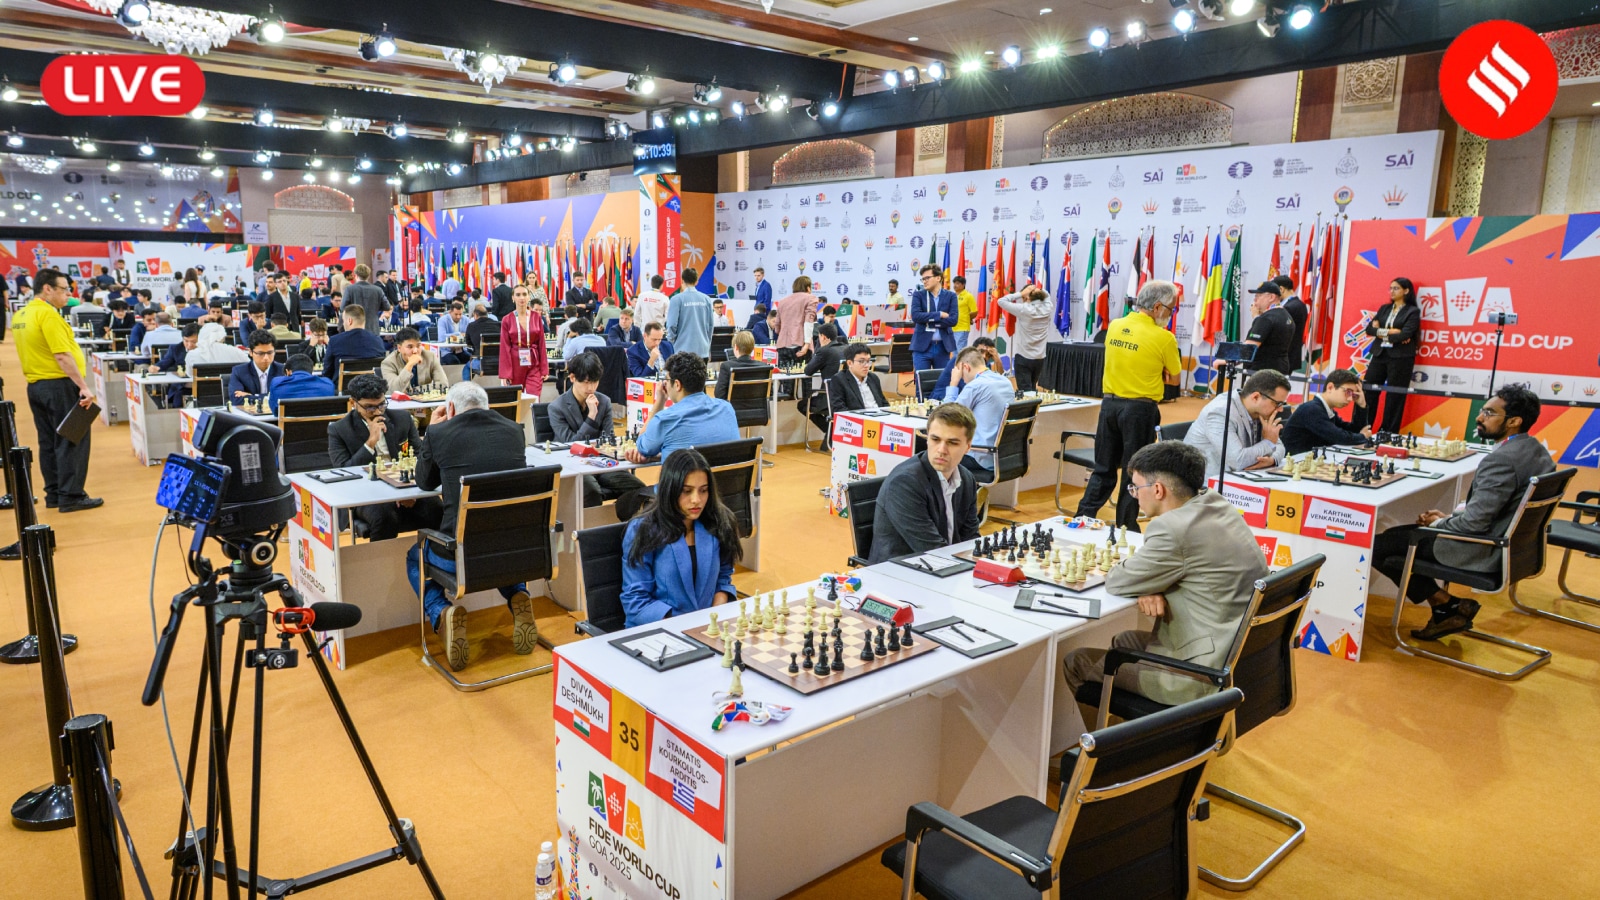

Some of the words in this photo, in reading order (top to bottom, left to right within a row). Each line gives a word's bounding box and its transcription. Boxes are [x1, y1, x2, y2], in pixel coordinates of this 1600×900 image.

[638, 143, 672, 160] :10:39
[1385, 149, 1415, 167] SAI
[1143, 168, 1164, 183] SAI
[913, 187, 927, 198] SAI
[1275, 193, 1301, 209] SAI
[1063, 203, 1081, 216] SAI
[1109, 339, 1139, 352] ARBITER
[1420, 330, 1450, 344] IDE
[1453, 331, 1526, 348] WORLD
[1528, 335, 1574, 350] CUP
[1416, 345, 1441, 359] OA
[1444, 347, 1484, 361] 2025
[866, 429, 877, 439] 57
[848, 472, 860, 481] FIDE
[303, 503, 311, 518] 33
[1227, 498, 1250, 508] ANTOJA
[1275, 504, 1296, 518] 59
[1310, 513, 1365, 528] VENKATARAMAN
[1323, 509, 1353, 519] KARTHIK
[570, 677, 594, 702] DIVYA
[561, 685, 604, 724] DESHMUKH
[619, 721, 640, 752] 35
[666, 739, 702, 769] STAMATIS
[658, 746, 709, 784] KOURKOULOS-
[669, 765, 698, 790] ARDITIS
[588, 834, 608, 861] GOA
[609, 853, 632, 881] 2025
[588, 817, 612, 846] FIDE
[612, 836, 654, 881] WORLD
[655, 872, 681, 900] CUP
